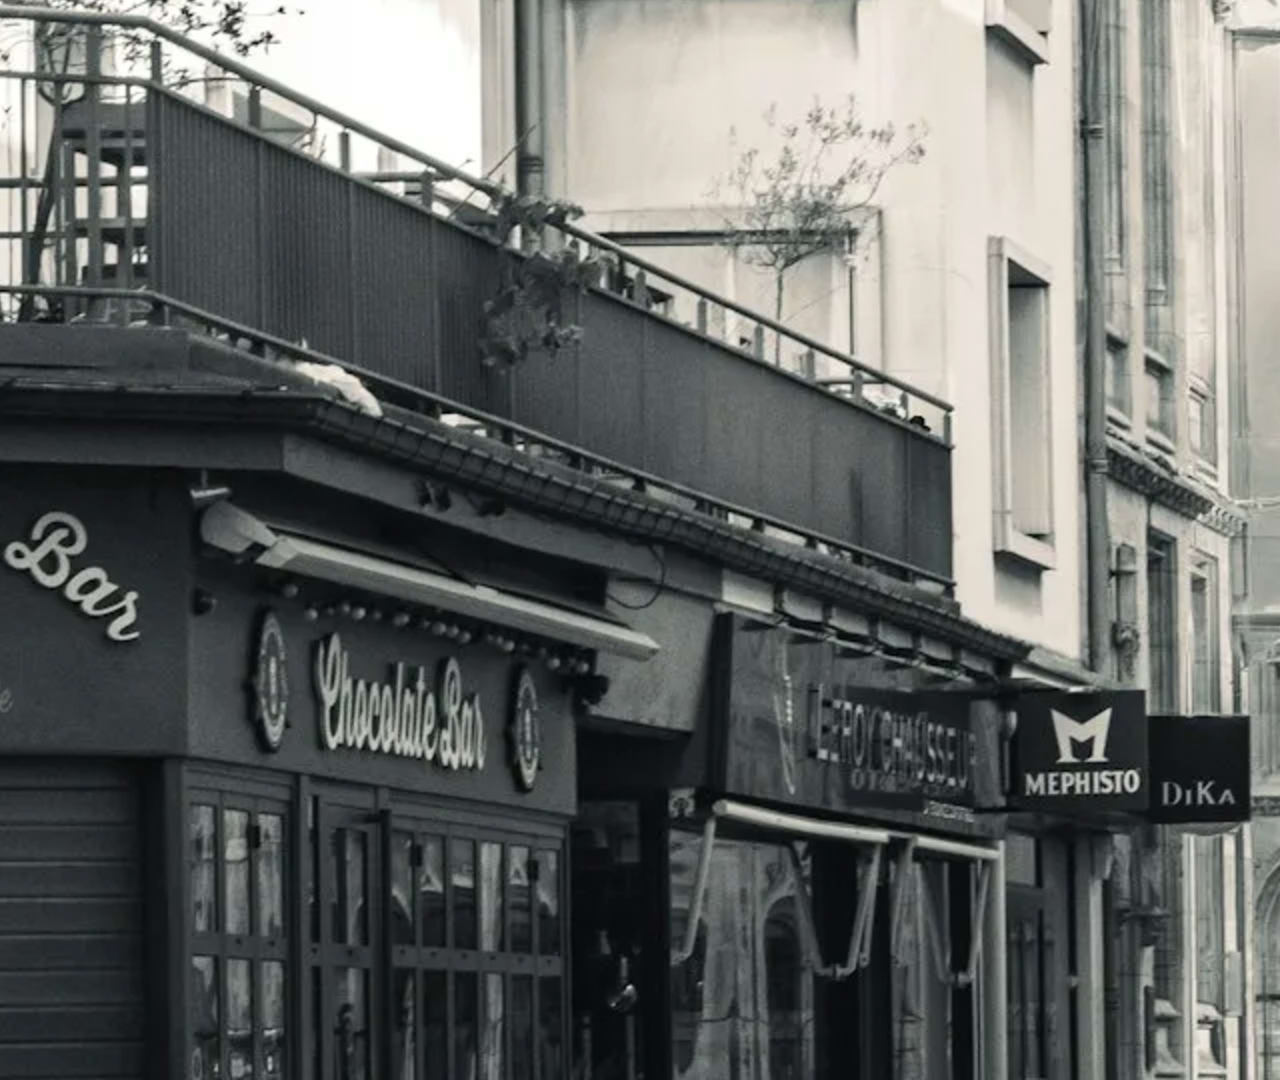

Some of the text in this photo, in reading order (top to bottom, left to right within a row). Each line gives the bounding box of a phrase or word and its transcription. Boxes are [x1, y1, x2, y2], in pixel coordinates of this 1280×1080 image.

[3, 511, 142, 641] Bar
[317, 631, 488, 771] Chocolate Bar
[1024, 769, 1141, 797] MEPHISTO
